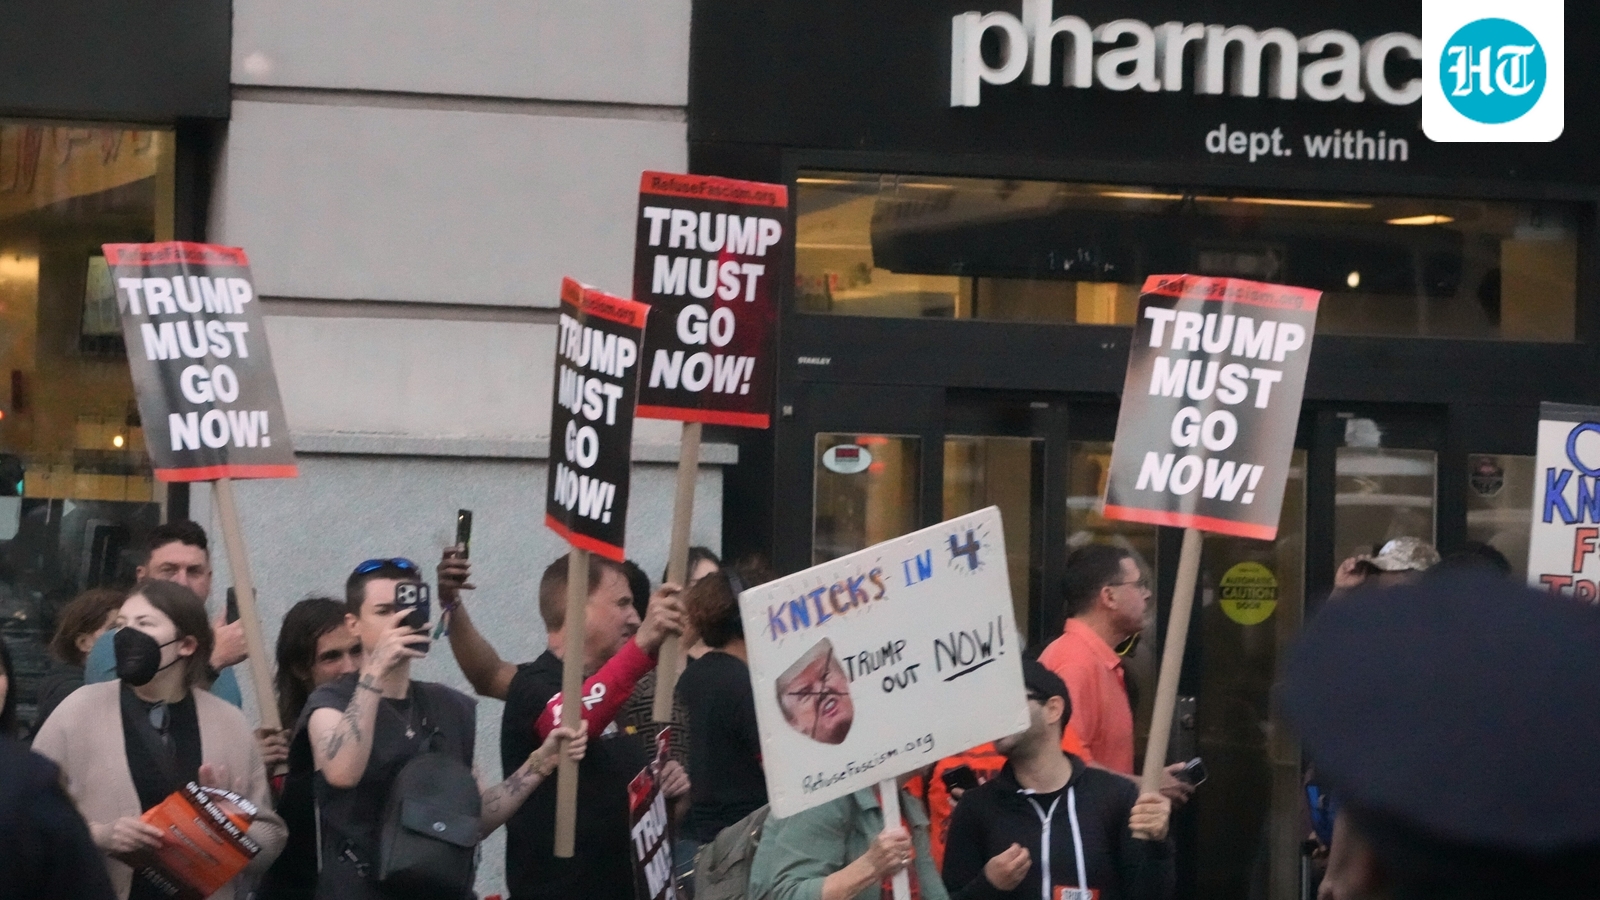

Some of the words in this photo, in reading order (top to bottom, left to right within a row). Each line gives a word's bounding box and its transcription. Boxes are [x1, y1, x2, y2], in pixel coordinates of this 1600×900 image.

[950, 0, 1422, 106] pharmac
[1206, 124, 1293, 162] dept.
[1304, 129, 1409, 162] within
[652, 177, 776, 204] RefuseFascism.org
[643, 205, 782, 257] TRUMP
[118, 275, 253, 315] TRUMP
[652, 255, 765, 302] MUST
[140, 320, 249, 360] MUST
[559, 313, 637, 378] TRUMP
[676, 304, 736, 347] GO
[1144, 306, 1306, 362] TRUMP
[180, 364, 239, 404] GO
[558, 364, 623, 426] MUST
[649, 349, 755, 395] NOW!
[1148, 356, 1283, 409] MUST
[168, 409, 271, 451] NOW!
[565, 419, 599, 469] GO
[1171, 406, 1238, 452] GO
[554, 462, 616, 524] NOW!
[1135, 451, 1265, 505] NOW!
[767, 566, 887, 642] KNICKS
[902, 549, 932, 587] IN
[949, 528, 981, 571] 4
[1222, 587, 1275, 599] CAUTION
[843, 639, 907, 683] TRUMP
[882, 663, 921, 693] OUT
[934, 615, 1005, 672] NOW!
[802, 733, 935, 794] RefuseFascism.org
